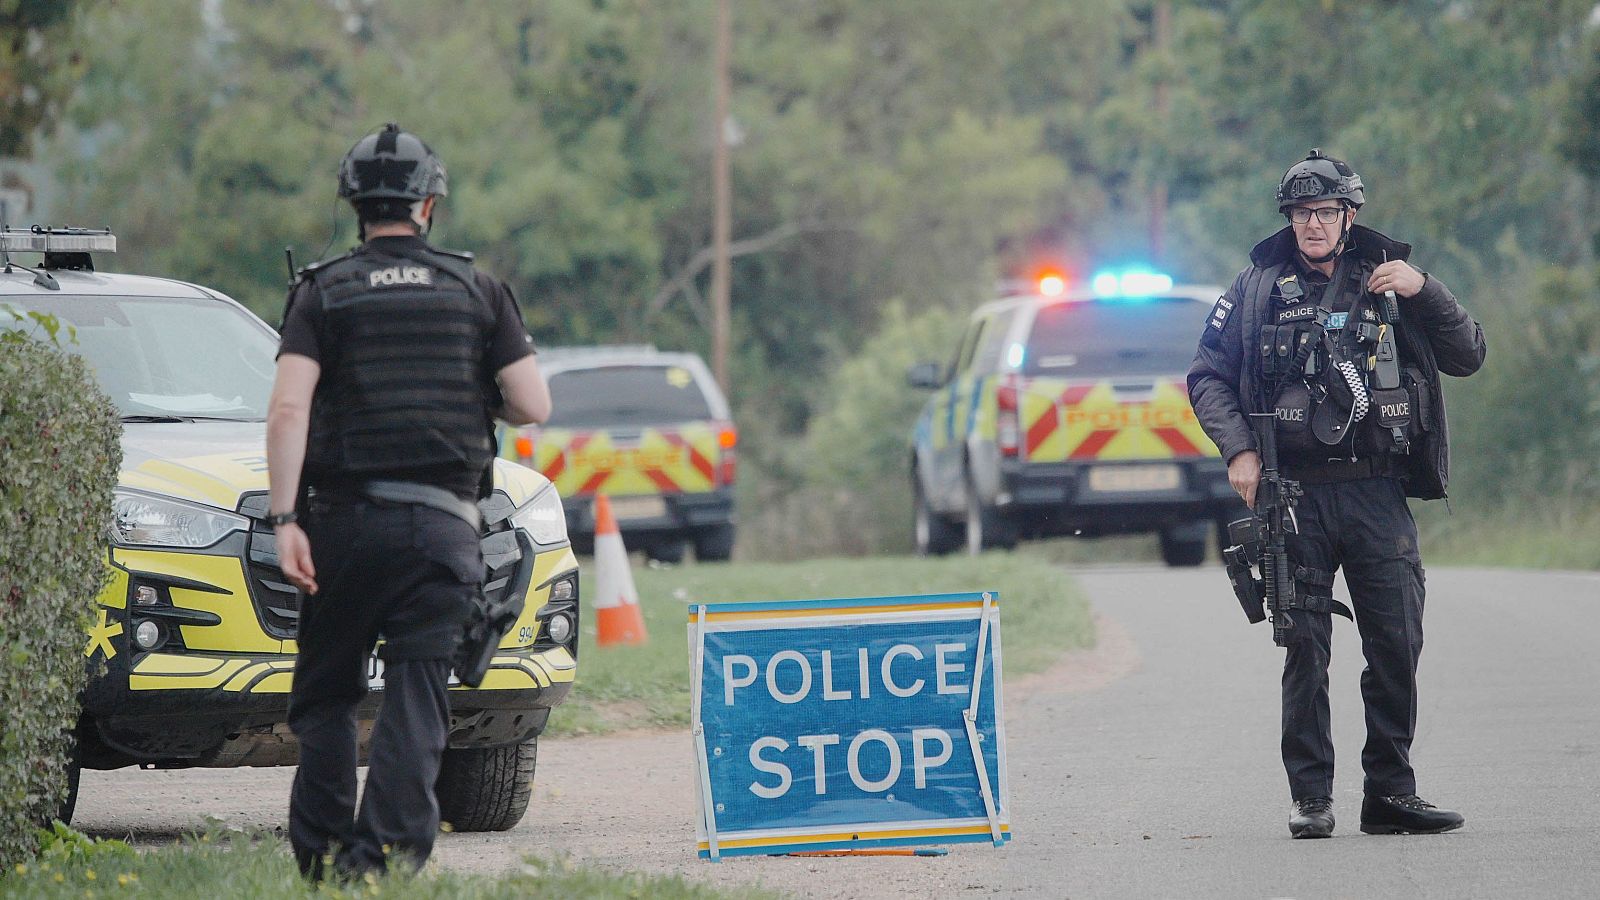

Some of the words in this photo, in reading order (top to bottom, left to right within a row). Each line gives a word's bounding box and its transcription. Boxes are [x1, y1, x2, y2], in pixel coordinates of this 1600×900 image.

[370, 265, 432, 287] POLICE
[1218, 297, 1233, 310] POLICE
[1215, 307, 1226, 320] MD
[1279, 307, 1314, 321] POLICE
[1275, 407, 1304, 421] POLICE
[1381, 402, 1409, 417] POLICE
[722, 643, 970, 706] POLICE
[748, 728, 954, 799] STOP
